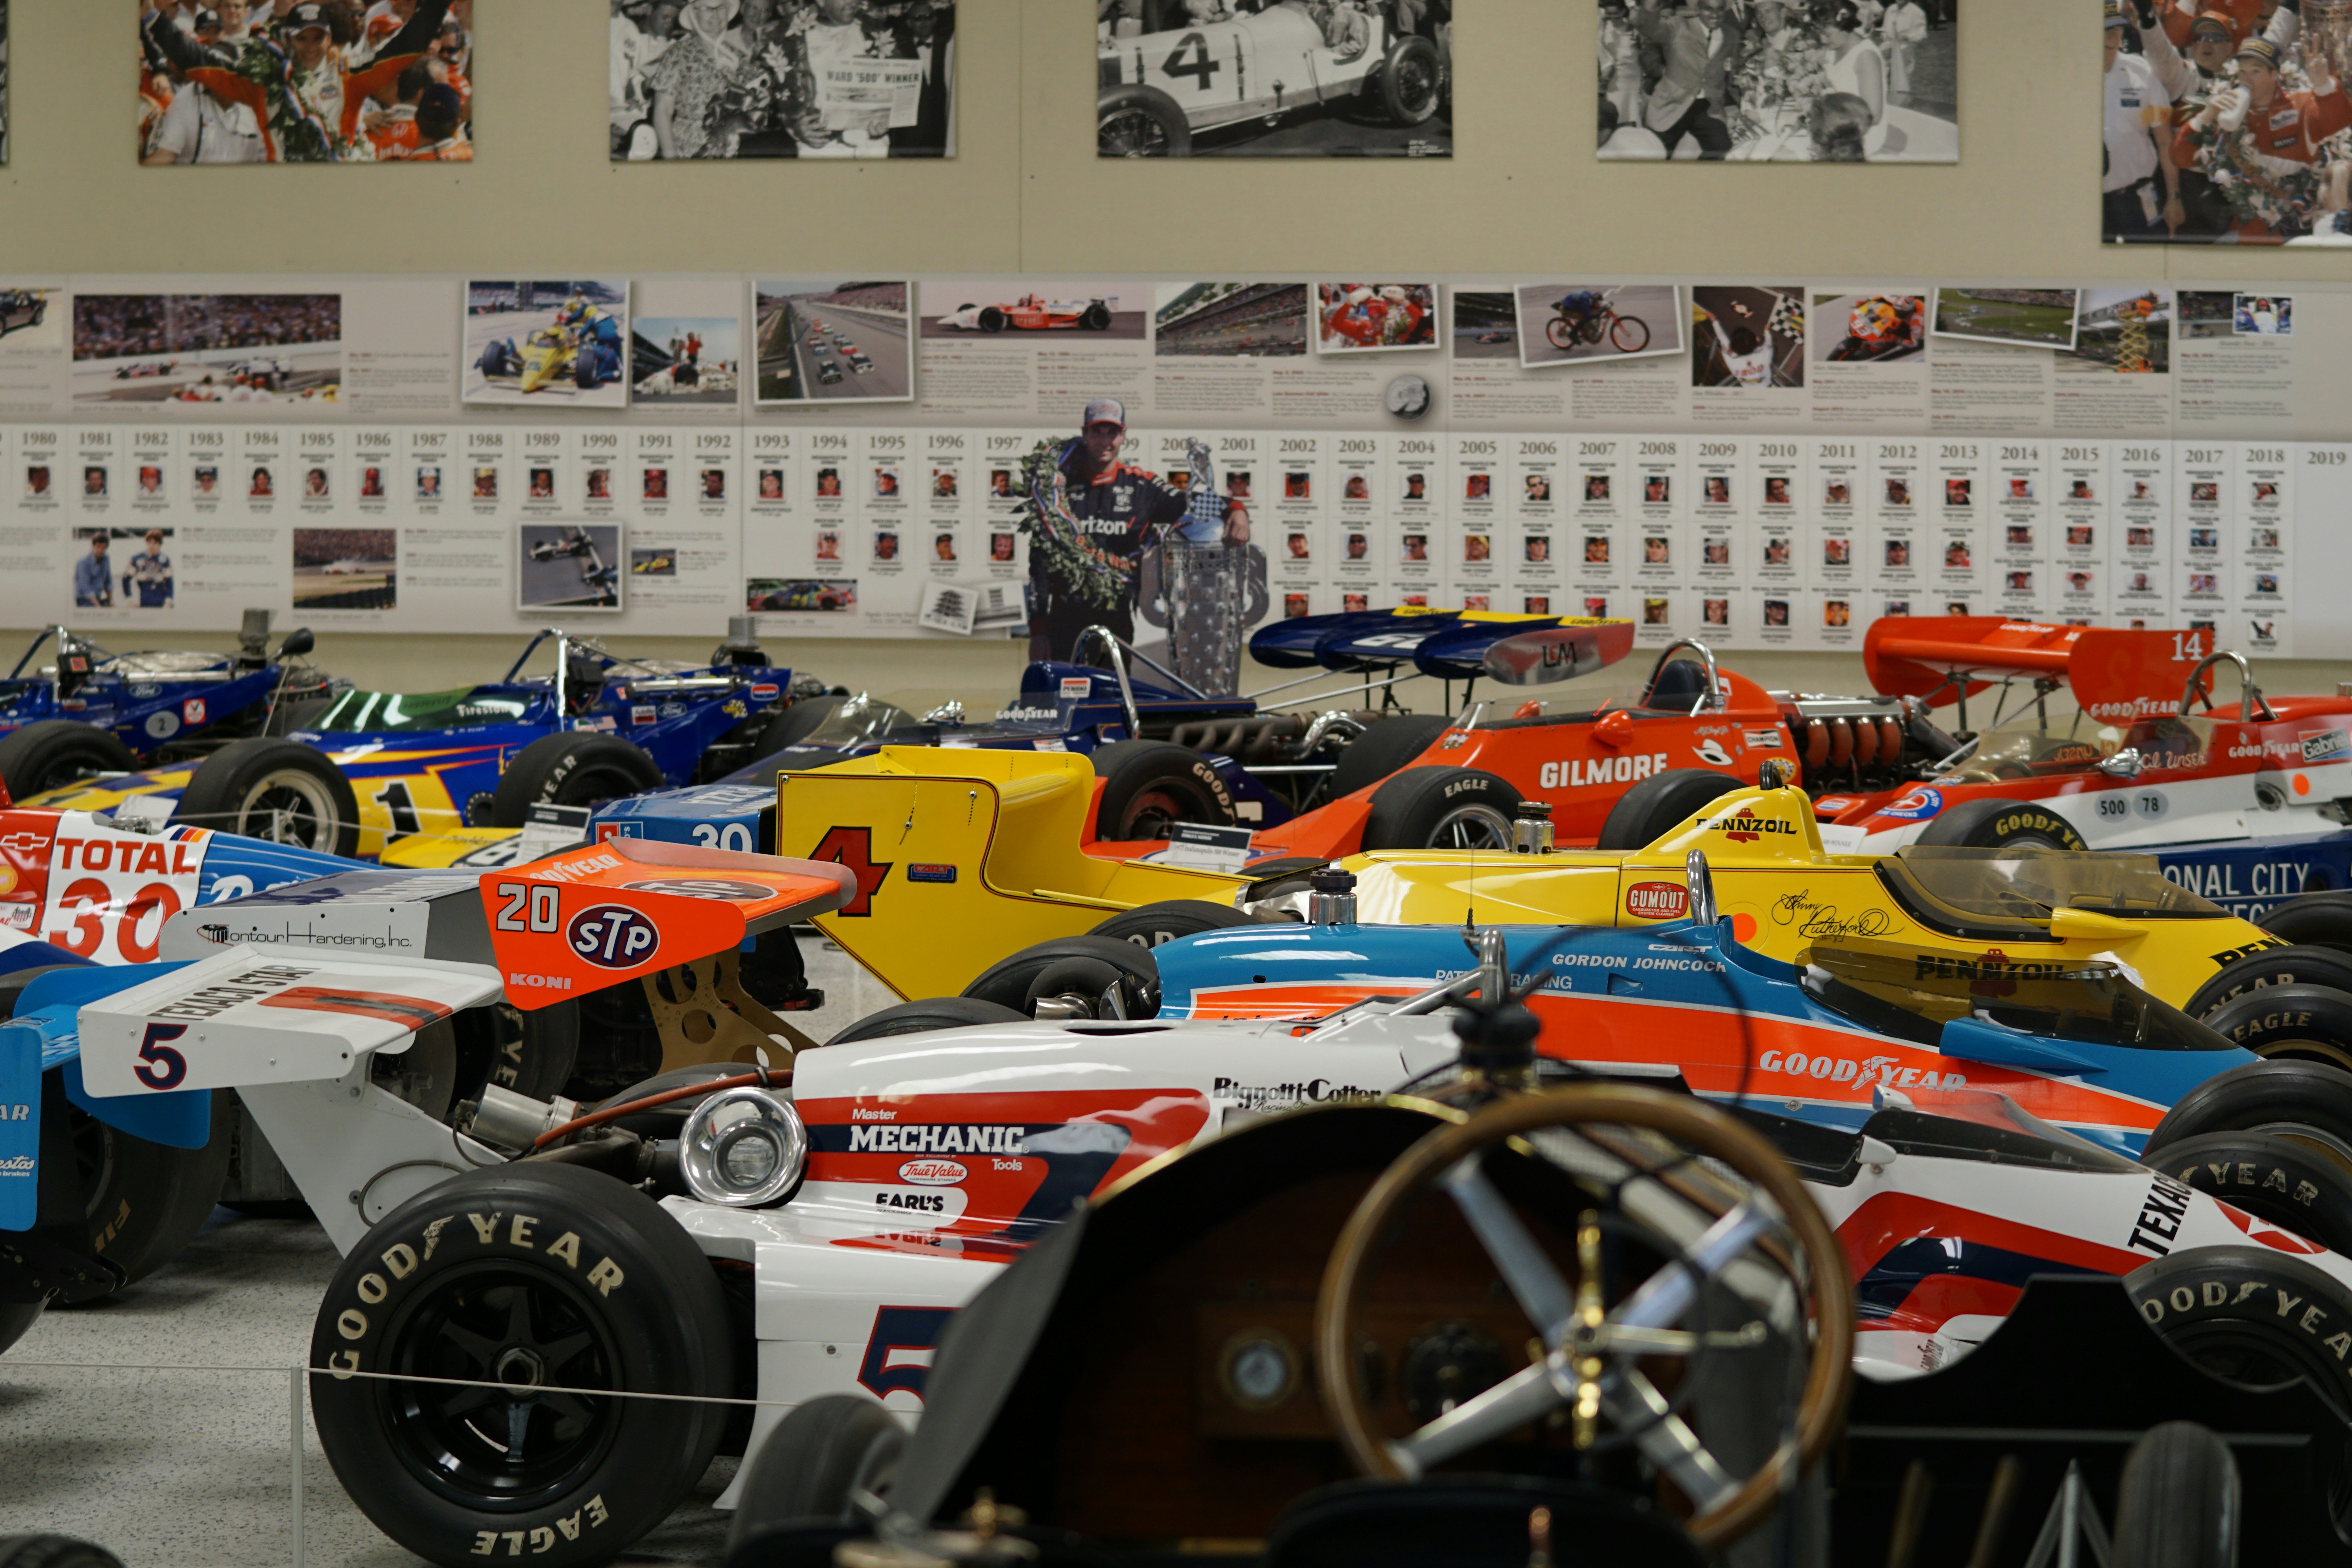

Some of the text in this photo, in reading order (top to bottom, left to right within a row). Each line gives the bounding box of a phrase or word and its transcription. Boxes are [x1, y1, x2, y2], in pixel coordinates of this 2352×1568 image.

[1162, 32, 1220, 90] 4
[827, 71, 853, 83] WARD
[884, 73, 920, 83] WINNER
[23, 432, 57, 445] 1980
[80, 432, 112, 445] 1981
[135, 432, 168, 446] 1982
[190, 432, 224, 446] 1983
[245, 432, 279, 445] 1984
[301, 432, 335, 446] 1985
[357, 433, 391, 446] 1986
[412, 433, 447, 446] 1987
[468, 433, 503, 447] 1988
[525, 433, 561, 446] 1989
[582, 434, 618, 447] 1990
[639, 434, 672, 448] 1991
[696, 434, 731, 448] 1992
[755, 434, 790, 449] 1993
[812, 435, 848, 448] 1994
[870, 435, 906, 449] 1995
[928, 435, 964, 448] 1996
[987, 436, 1022, 450] 1997
[1220, 437, 1255, 451] 2001
[1279, 439, 1316, 453] 2002
[1338, 439, 1376, 454] 2003
[1398, 440, 1436, 454] 2004
[1459, 440, 1497, 455] 2005
[1519, 441, 1557, 455] 2006
[1579, 441, 1617, 456] 2007
[1639, 441, 1677, 455] 2008
[1699, 443, 1737, 457] 2009
[1759, 443, 1798, 457] 2010
[1819, 444, 1855, 458] 2011
[1879, 445, 1917, 459] 2012
[1940, 445, 1978, 459] 2013
[2000, 446, 2039, 460] 2014
[2061, 447, 2100, 461] 2015
[2122, 448, 2161, 462] 2016
[2185, 449, 2224, 463] 2017
[2246, 448, 2285, 463] 2018
[2307, 451, 2347, 465] 2019
[2171, 632, 2203, 661] 14
[158, 718, 166, 732] 2
[1540, 753, 1667, 789] GILMORE
[1444, 779, 1489, 798] EAGLE
[373, 780, 422, 846] 1
[2100, 797, 2159, 815] 500 78
[1696, 818, 1798, 835] PENNZOIL
[692, 823, 753, 853] 30
[56, 838, 196, 875] TOTAL
[914, 864, 951, 874] CART
[2251, 862, 2310, 896] CITY
[1630, 889, 1685, 909] GUMOUT
[496, 883, 560, 934] 20
[49, 877, 181, 964] 30
[287, 921, 386, 948] Hardening,
[388, 925, 412, 947] Inc.
[575, 911, 653, 960] STP
[1648, 944, 1713, 953] CART
[1552, 953, 1628, 968] GORDON
[510, 973, 571, 990] KONI
[147, 964, 321, 1021] TEXACO STAR
[2234, 1011, 2312, 1043] EAGLE
[132, 1022, 189, 1091] 5
[852, 1108, 897, 1120] Master
[849, 1125, 1025, 1153] MECHANIC
[991, 1158, 1023, 1171] Tools
[876, 1193, 944, 1212] EARL'S
[2127, 1171, 2195, 1256] TEXAC
[470, 1494, 610, 1556] EAGLE
